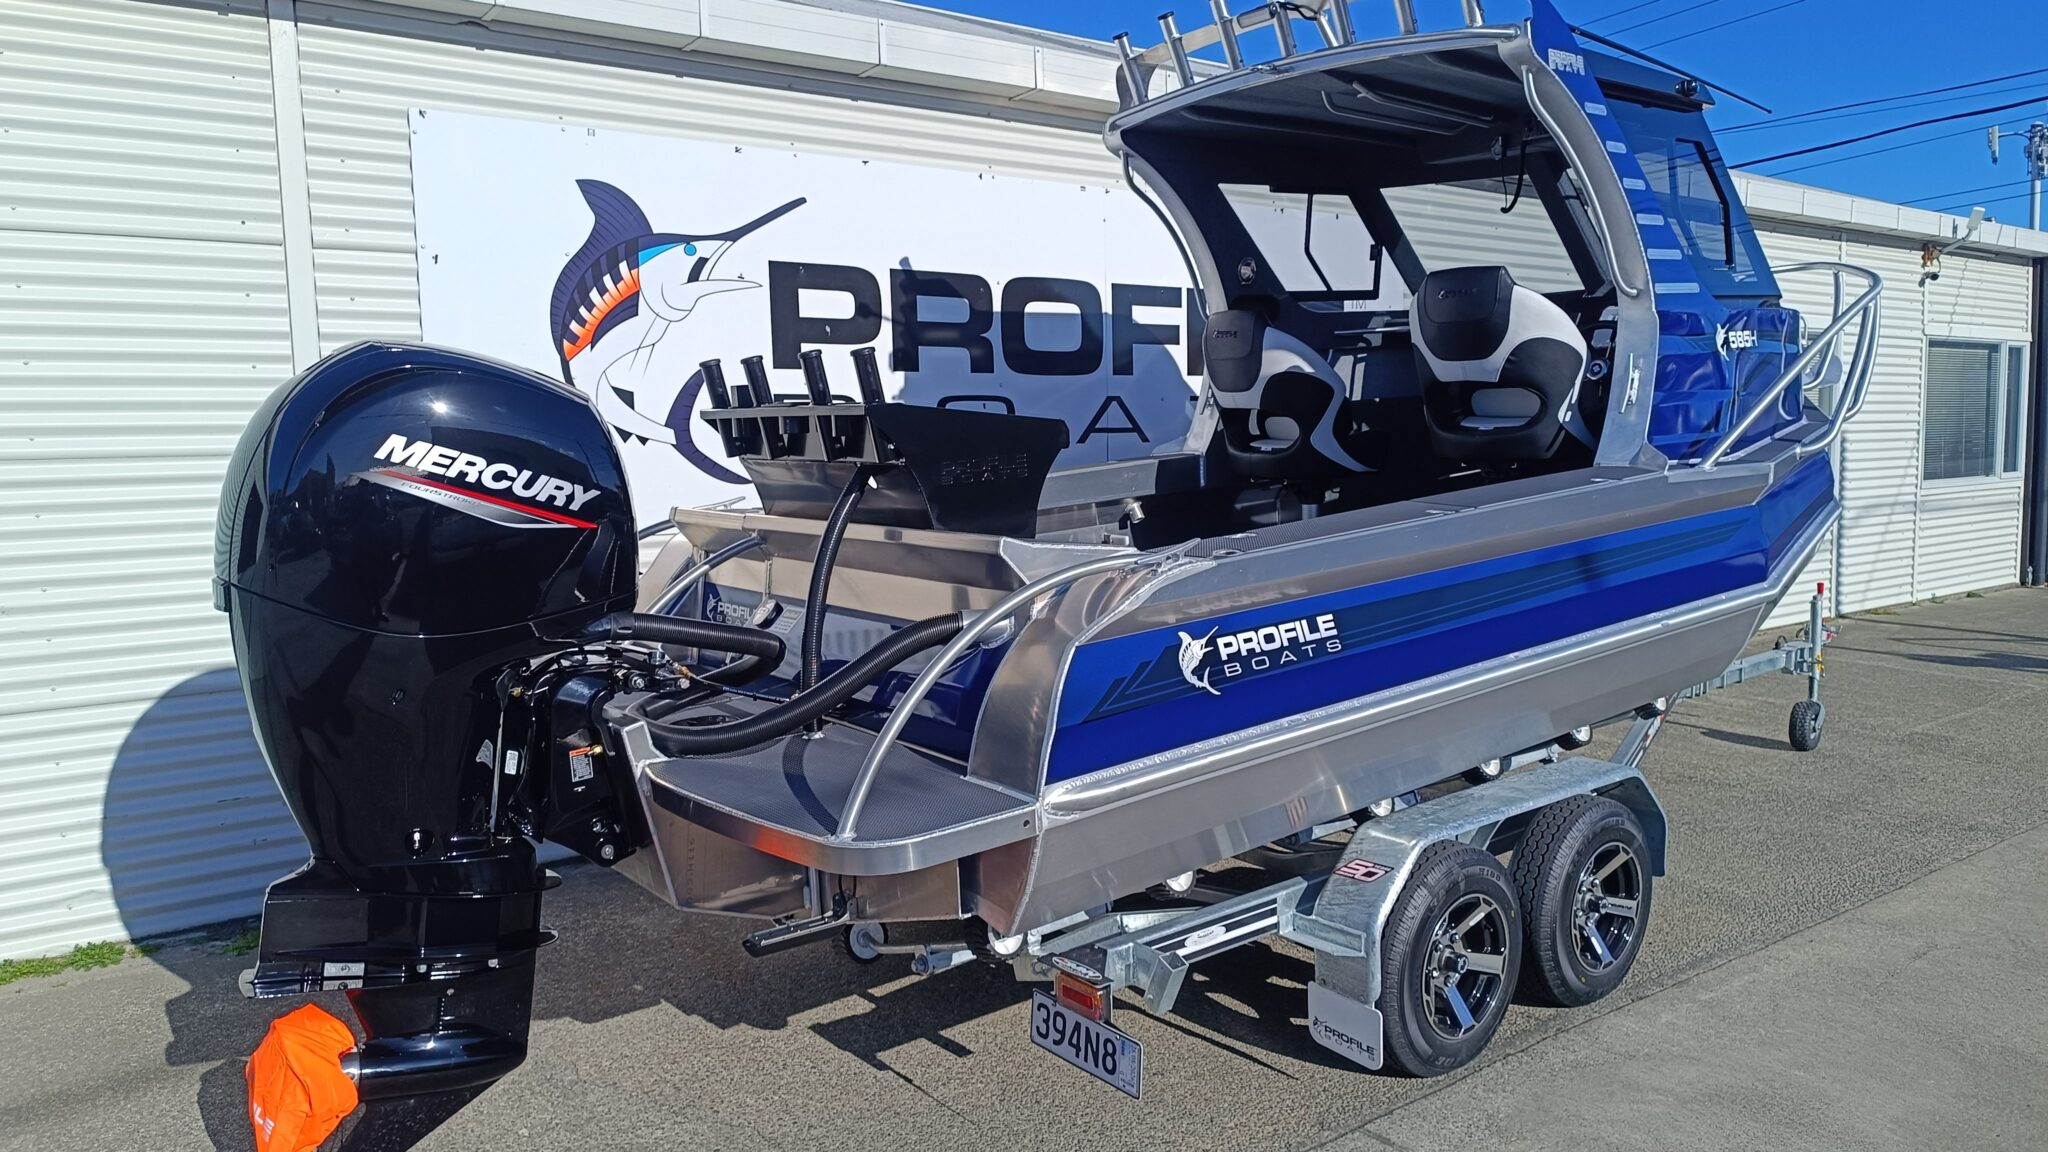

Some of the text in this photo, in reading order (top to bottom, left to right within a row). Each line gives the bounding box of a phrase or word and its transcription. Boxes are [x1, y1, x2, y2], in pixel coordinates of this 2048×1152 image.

[769, 260, 1204, 376] PROFI
[1728, 330, 1758, 348] 585H
[373, 433, 601, 511] MERCURY
[717, 601, 752, 619] PROFIL
[1216, 613, 1338, 661] PROFILE
[1223, 639, 1342, 677] BOATS
[1036, 1002, 1117, 1076] 394N8
[1324, 1025, 1376, 1055] PROFILE
[1325, 1031, 1375, 1061] BOATS
